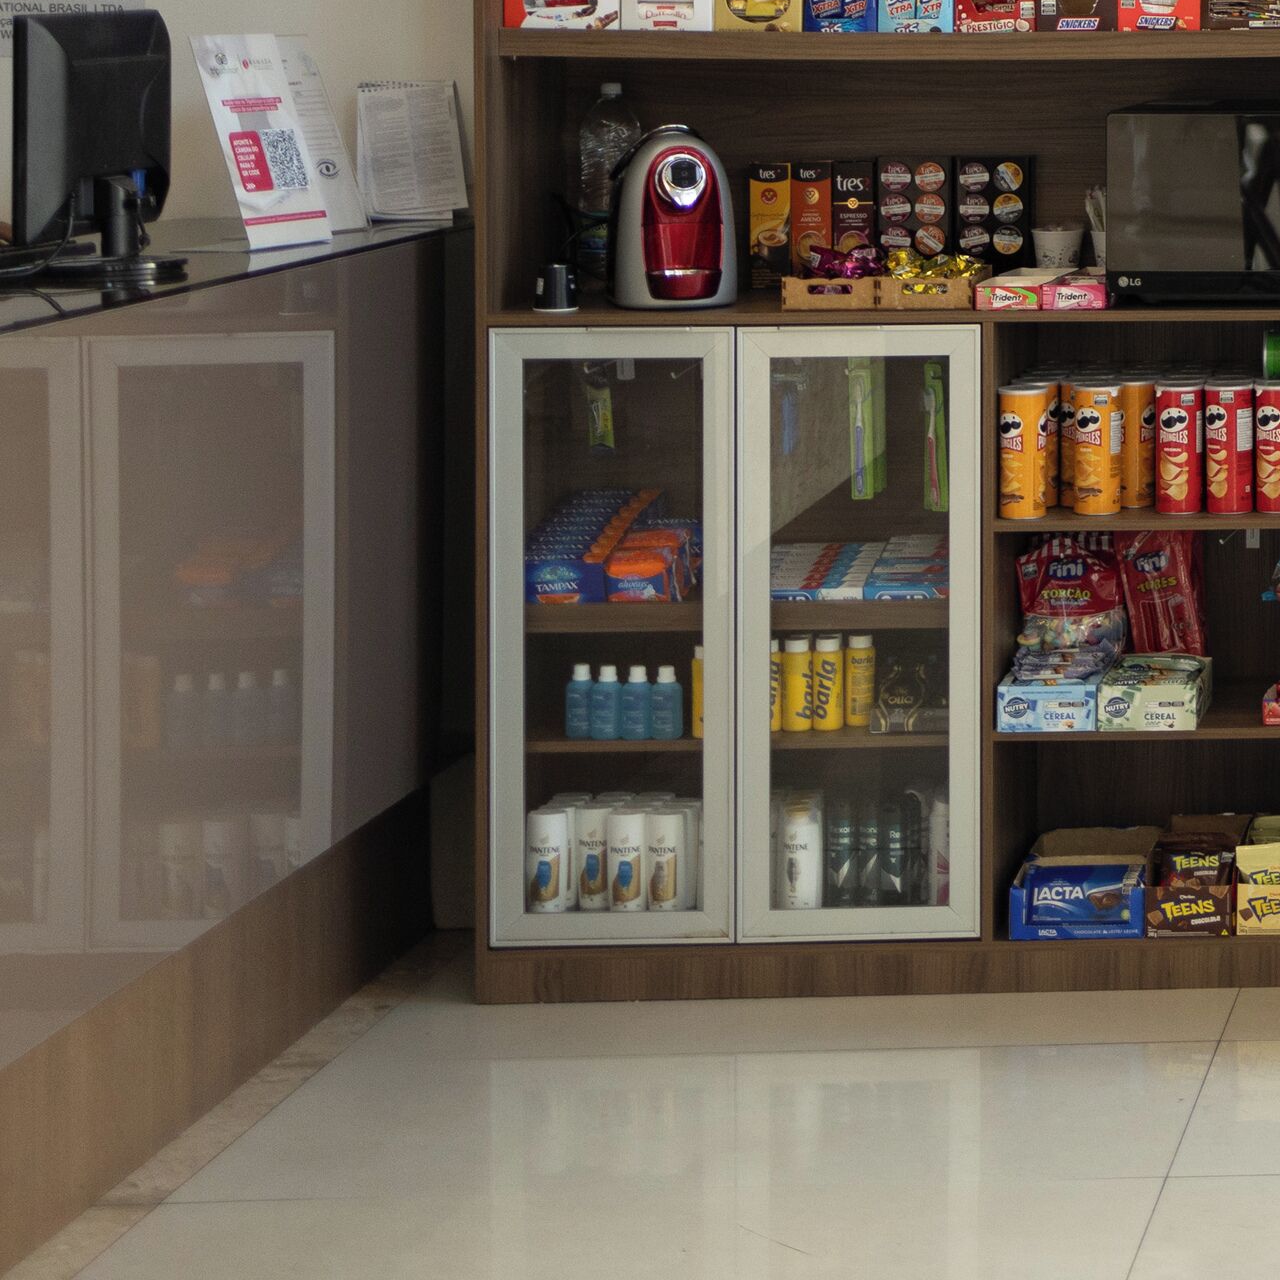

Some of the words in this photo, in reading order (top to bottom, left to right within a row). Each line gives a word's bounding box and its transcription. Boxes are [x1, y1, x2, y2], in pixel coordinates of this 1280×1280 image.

[966, 20, 1014, 32] PRESTIGIO
[1059, 19, 1098, 30] SNICKERS
[1138, 16, 1176, 29] SNICKERS
[1129, 278, 1142, 287] LG
[991, 292, 1022, 303] Trident
[1056, 290, 1088, 302] Trident
[1160, 429, 1188, 444] PRINGLES
[1256, 427, 1280, 442] PRINGLES
[535, 581, 579, 593] TAMPAX
[617, 581, 648, 589] always
[813, 659, 836, 720] barla
[1004, 703, 1029, 713] NUTRY
[1104, 703, 1130, 713] NUTRY
[1043, 711, 1076, 721] CEREAL
[1144, 711, 1176, 721] CEREAL
[529, 845, 560, 854] PANTENE
[610, 845, 641, 854] PANTENE
[648, 845, 676, 853] PANTENE
[1172, 853, 1220, 872] TEENS
[1033, 886, 1084, 907] LACTA
[1161, 899, 1217, 922] TEENS
